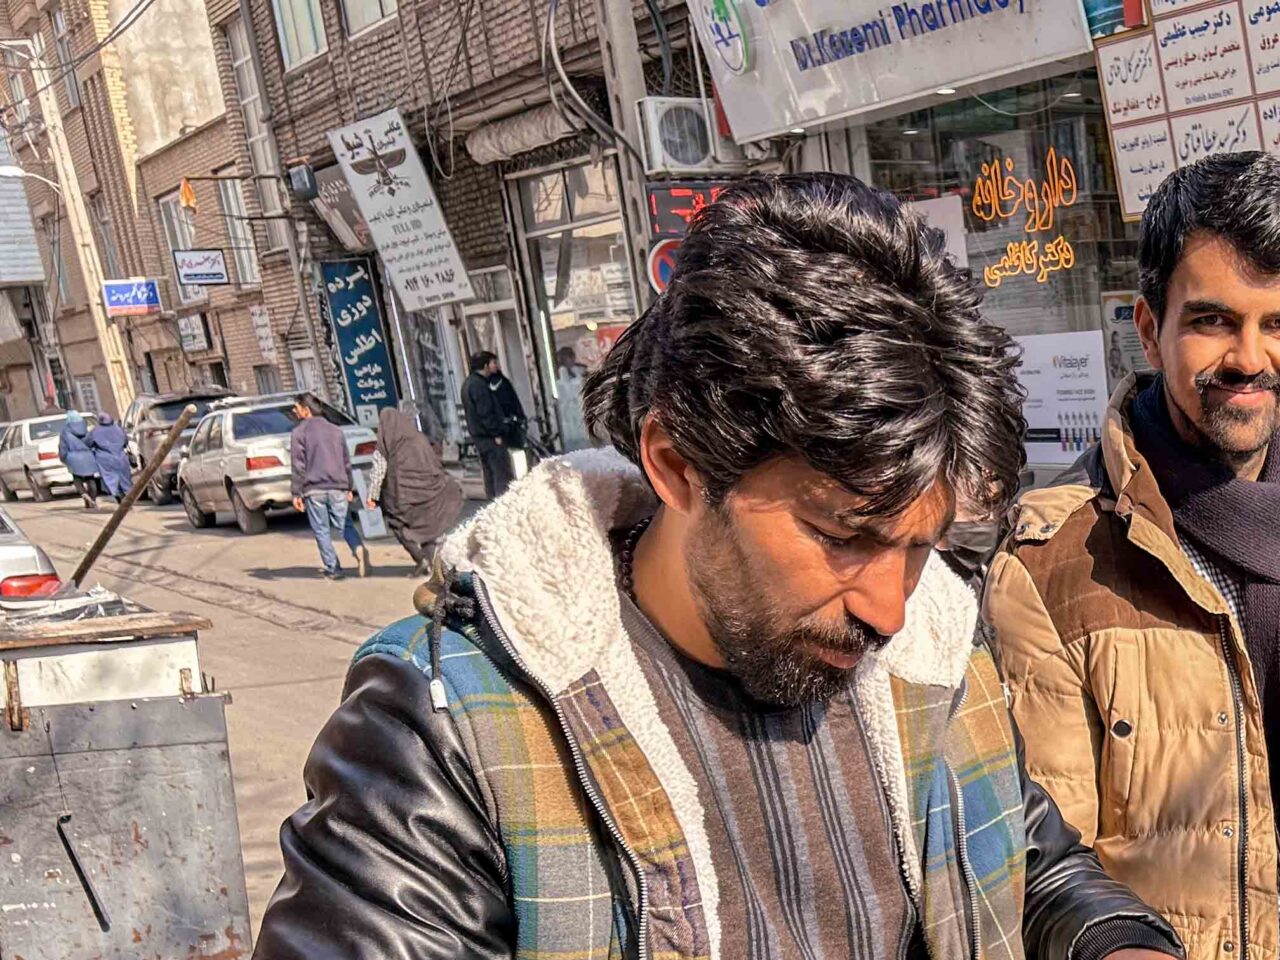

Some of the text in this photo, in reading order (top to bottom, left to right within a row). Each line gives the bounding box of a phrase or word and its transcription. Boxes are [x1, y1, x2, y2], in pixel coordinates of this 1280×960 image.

[790, 9, 892, 72] Dr.Kazemi
[327, 265, 369, 293] پرده
[984, 235, 1075, 288] دکتر کاظمی
[337, 294, 372, 327] دوزی
[345, 328, 382, 365] اطلس
